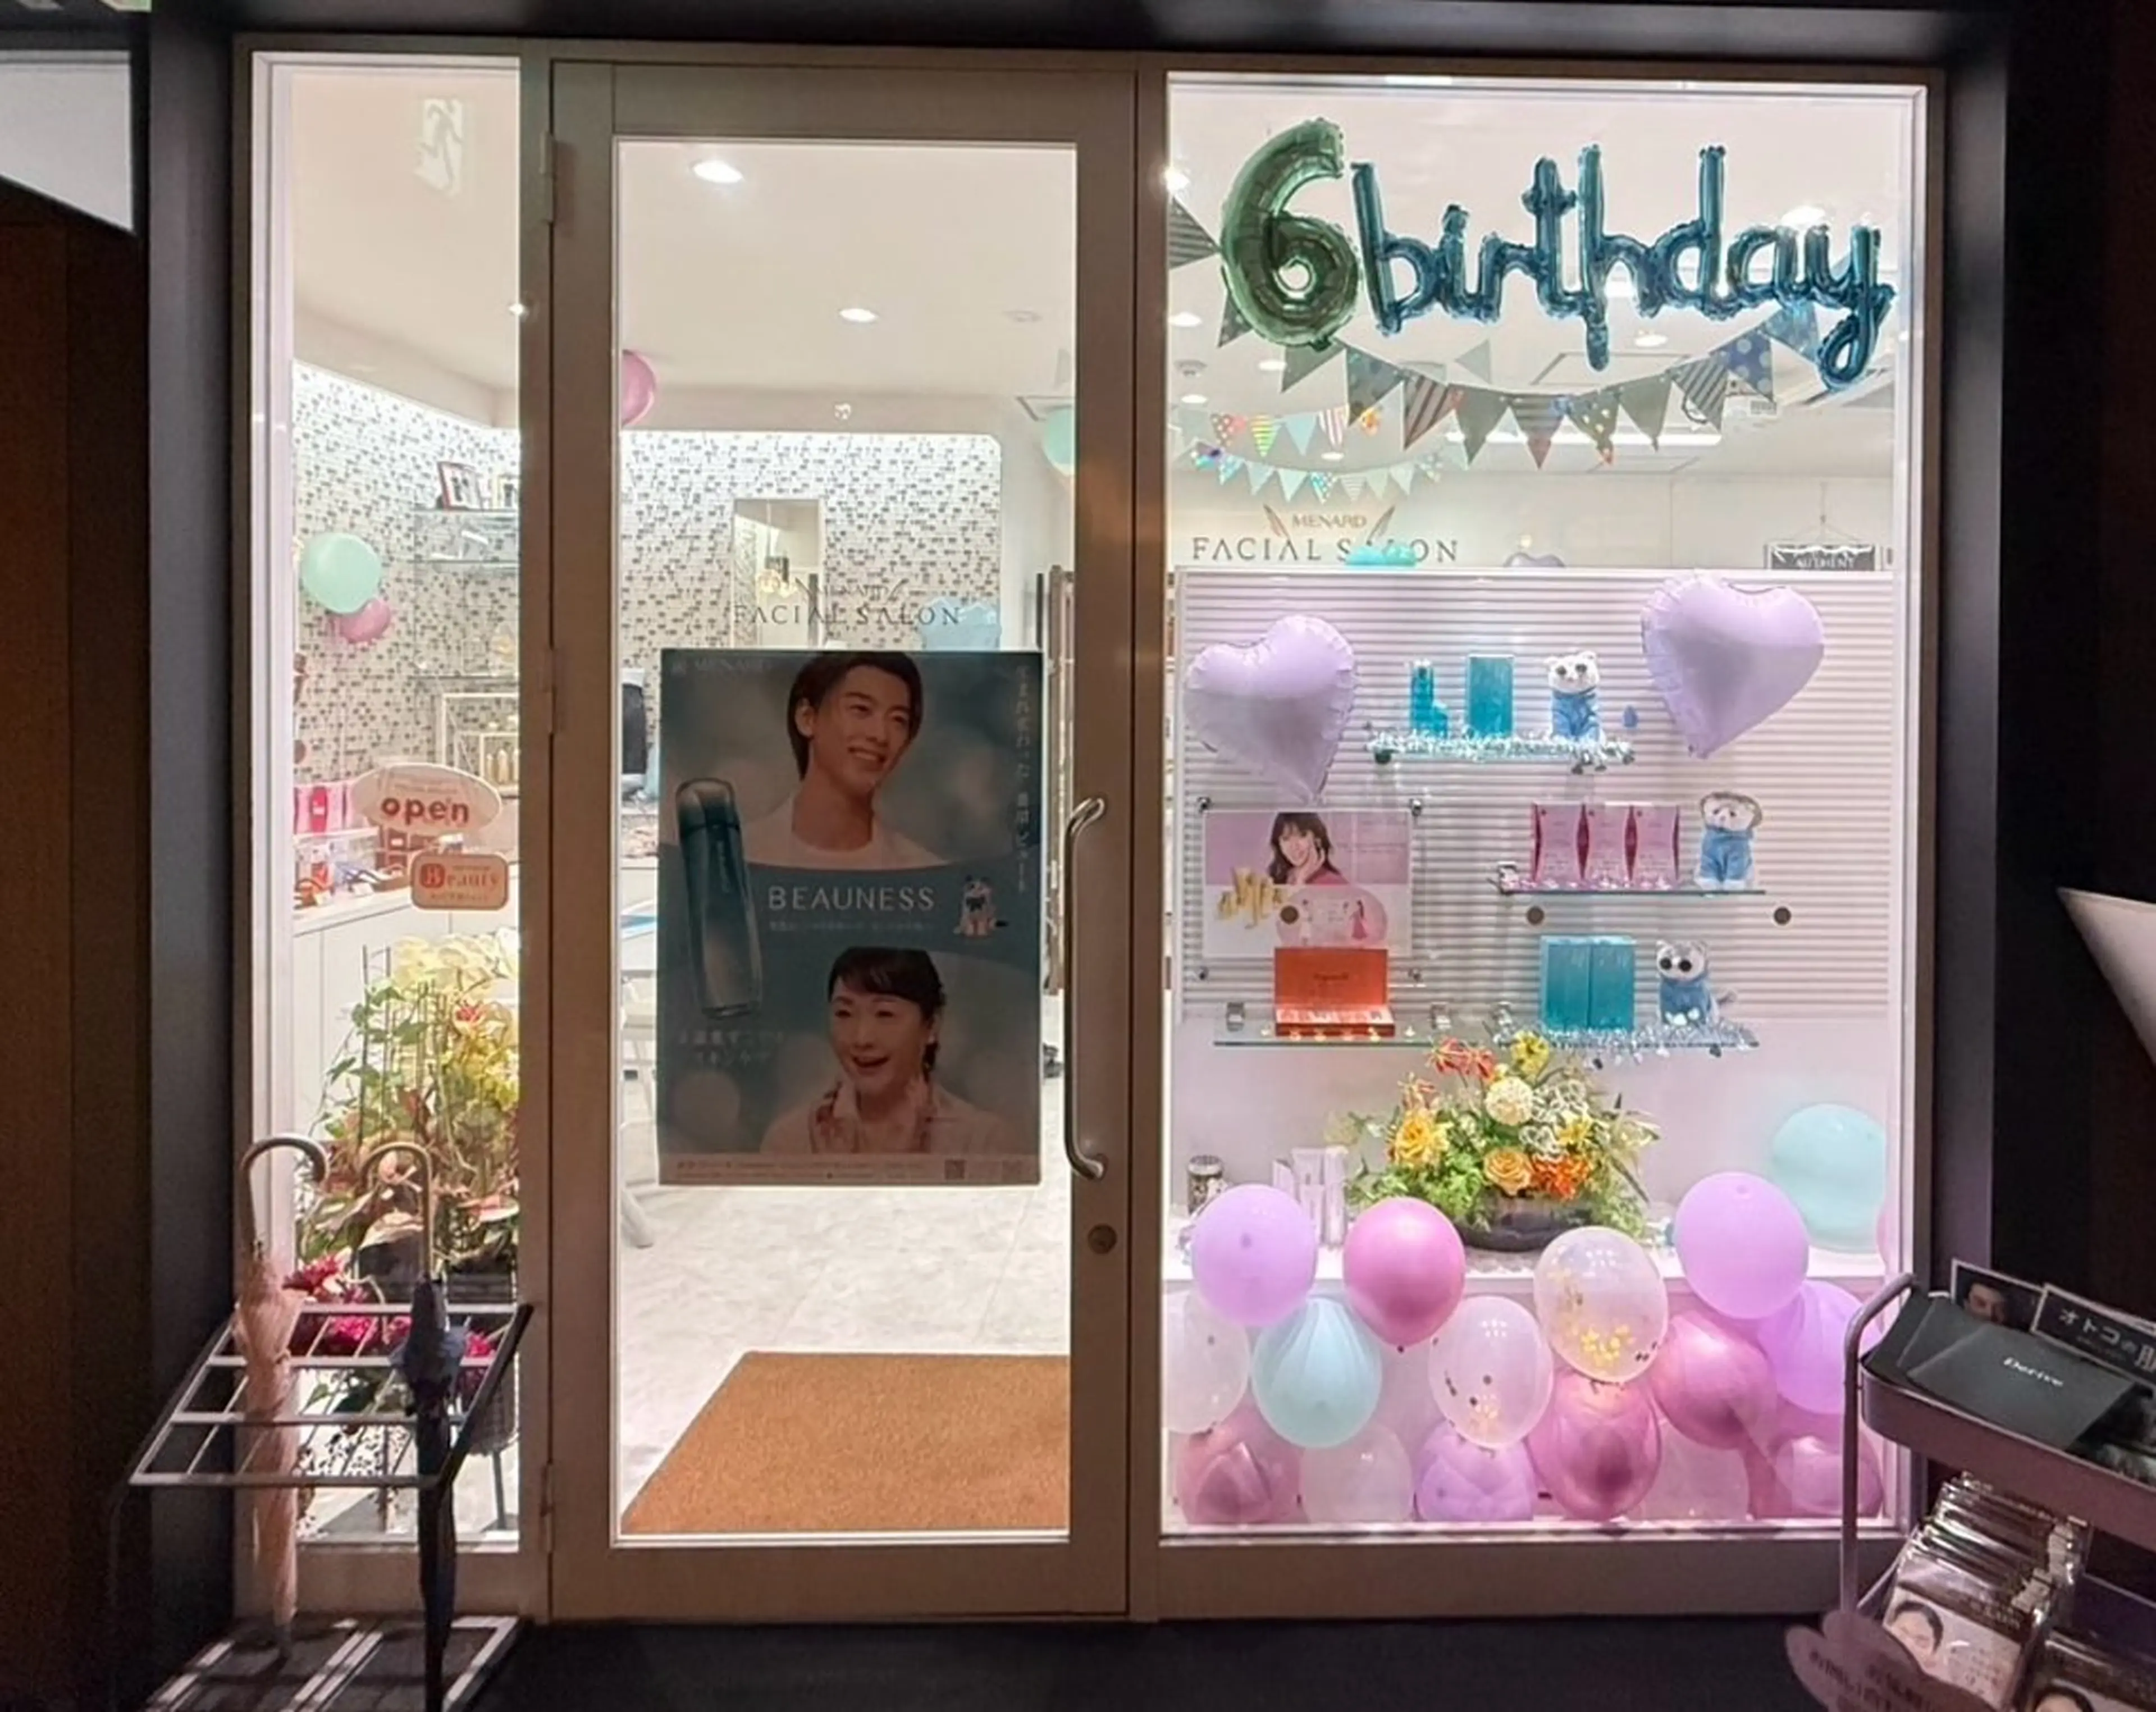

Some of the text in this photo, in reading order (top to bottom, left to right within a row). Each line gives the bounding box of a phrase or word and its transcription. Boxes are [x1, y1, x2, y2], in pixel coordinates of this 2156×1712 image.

[1221, 118, 1896, 391] 6 birthday
[1292, 515, 1367, 529] MENARD
[1192, 537, 1458, 561] FACIAL SON
[734, 605, 960, 625] FACIAL SALON
[381, 797, 469, 825] open
[768, 885, 935, 912] BEAUNESS
